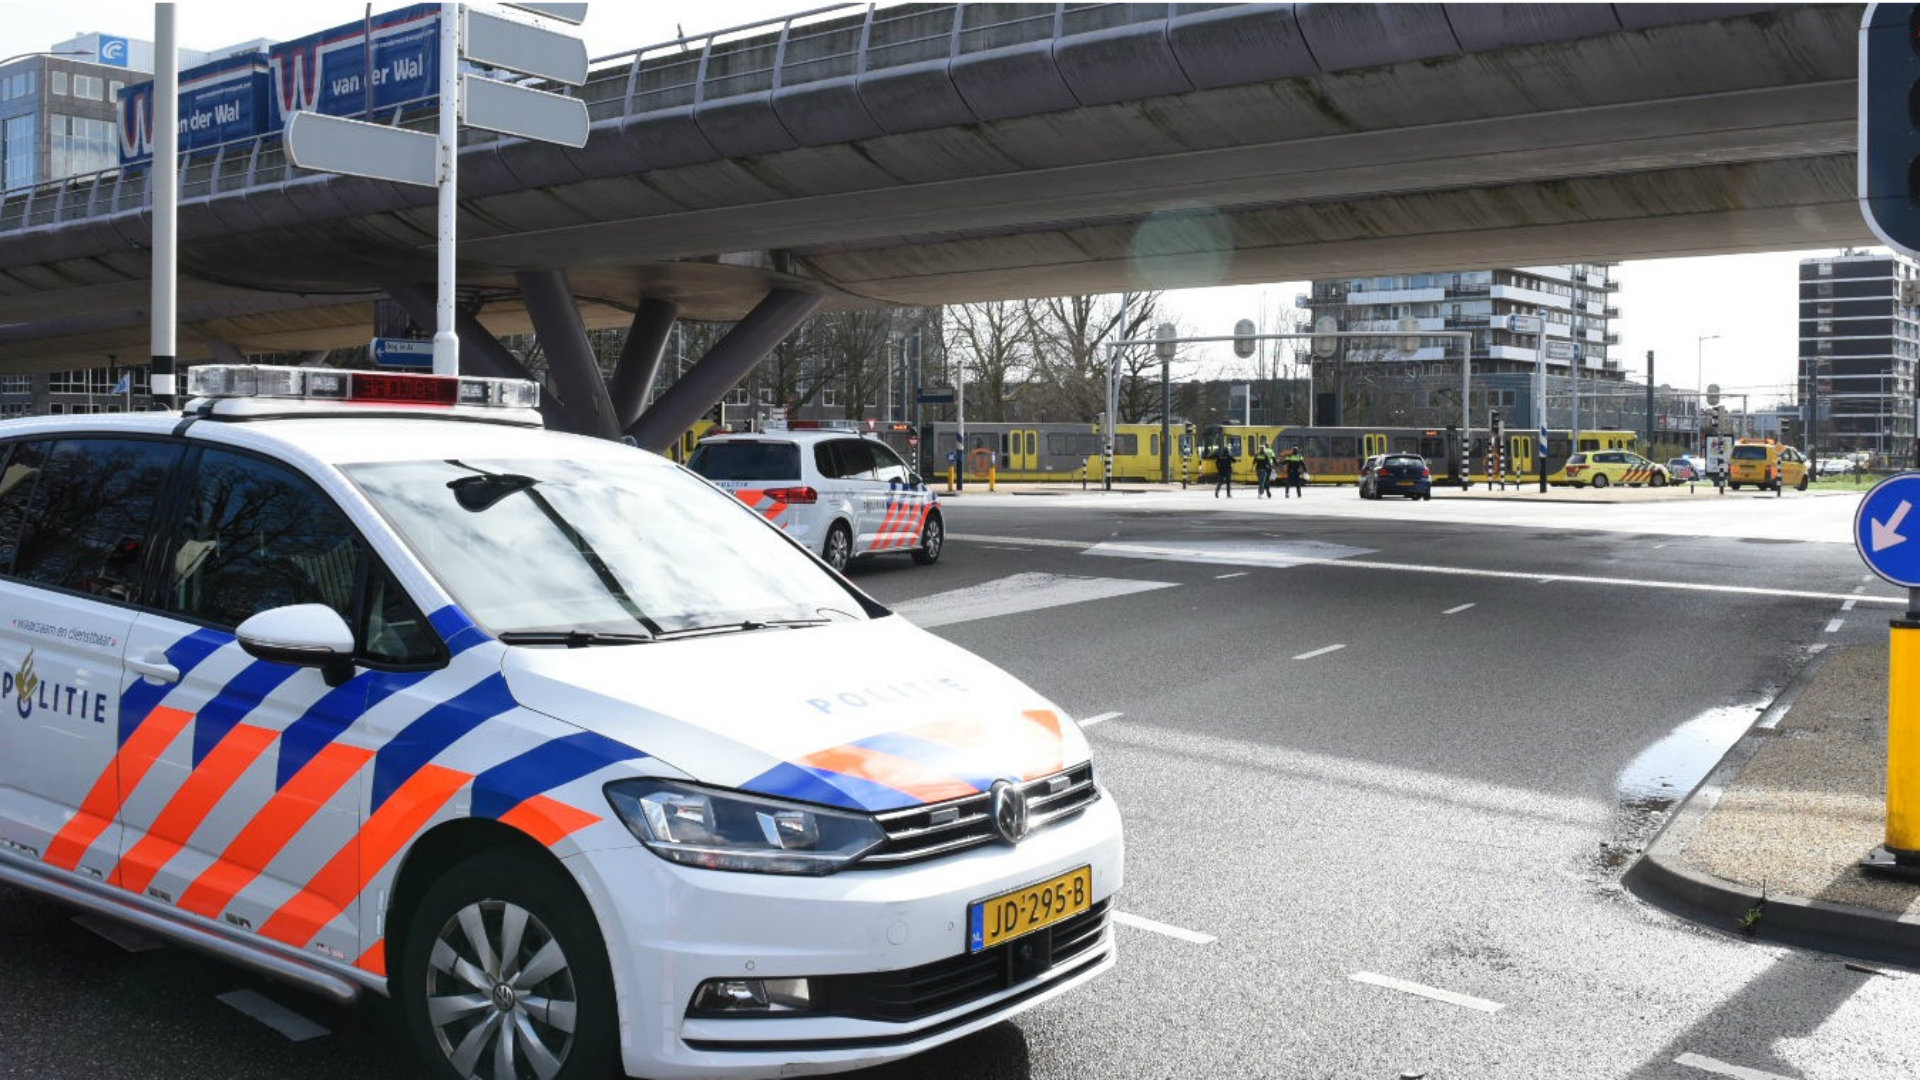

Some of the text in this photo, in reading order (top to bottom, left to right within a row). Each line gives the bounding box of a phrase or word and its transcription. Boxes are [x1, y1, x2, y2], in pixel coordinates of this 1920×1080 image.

[333, 74, 359, 96] van
[394, 53, 423, 82] Wal
[190, 109, 212, 130] der
[215, 99, 239, 125] Wal
[2, 671, 107, 724] POLITIE
[806, 678, 971, 714] POLITIE
